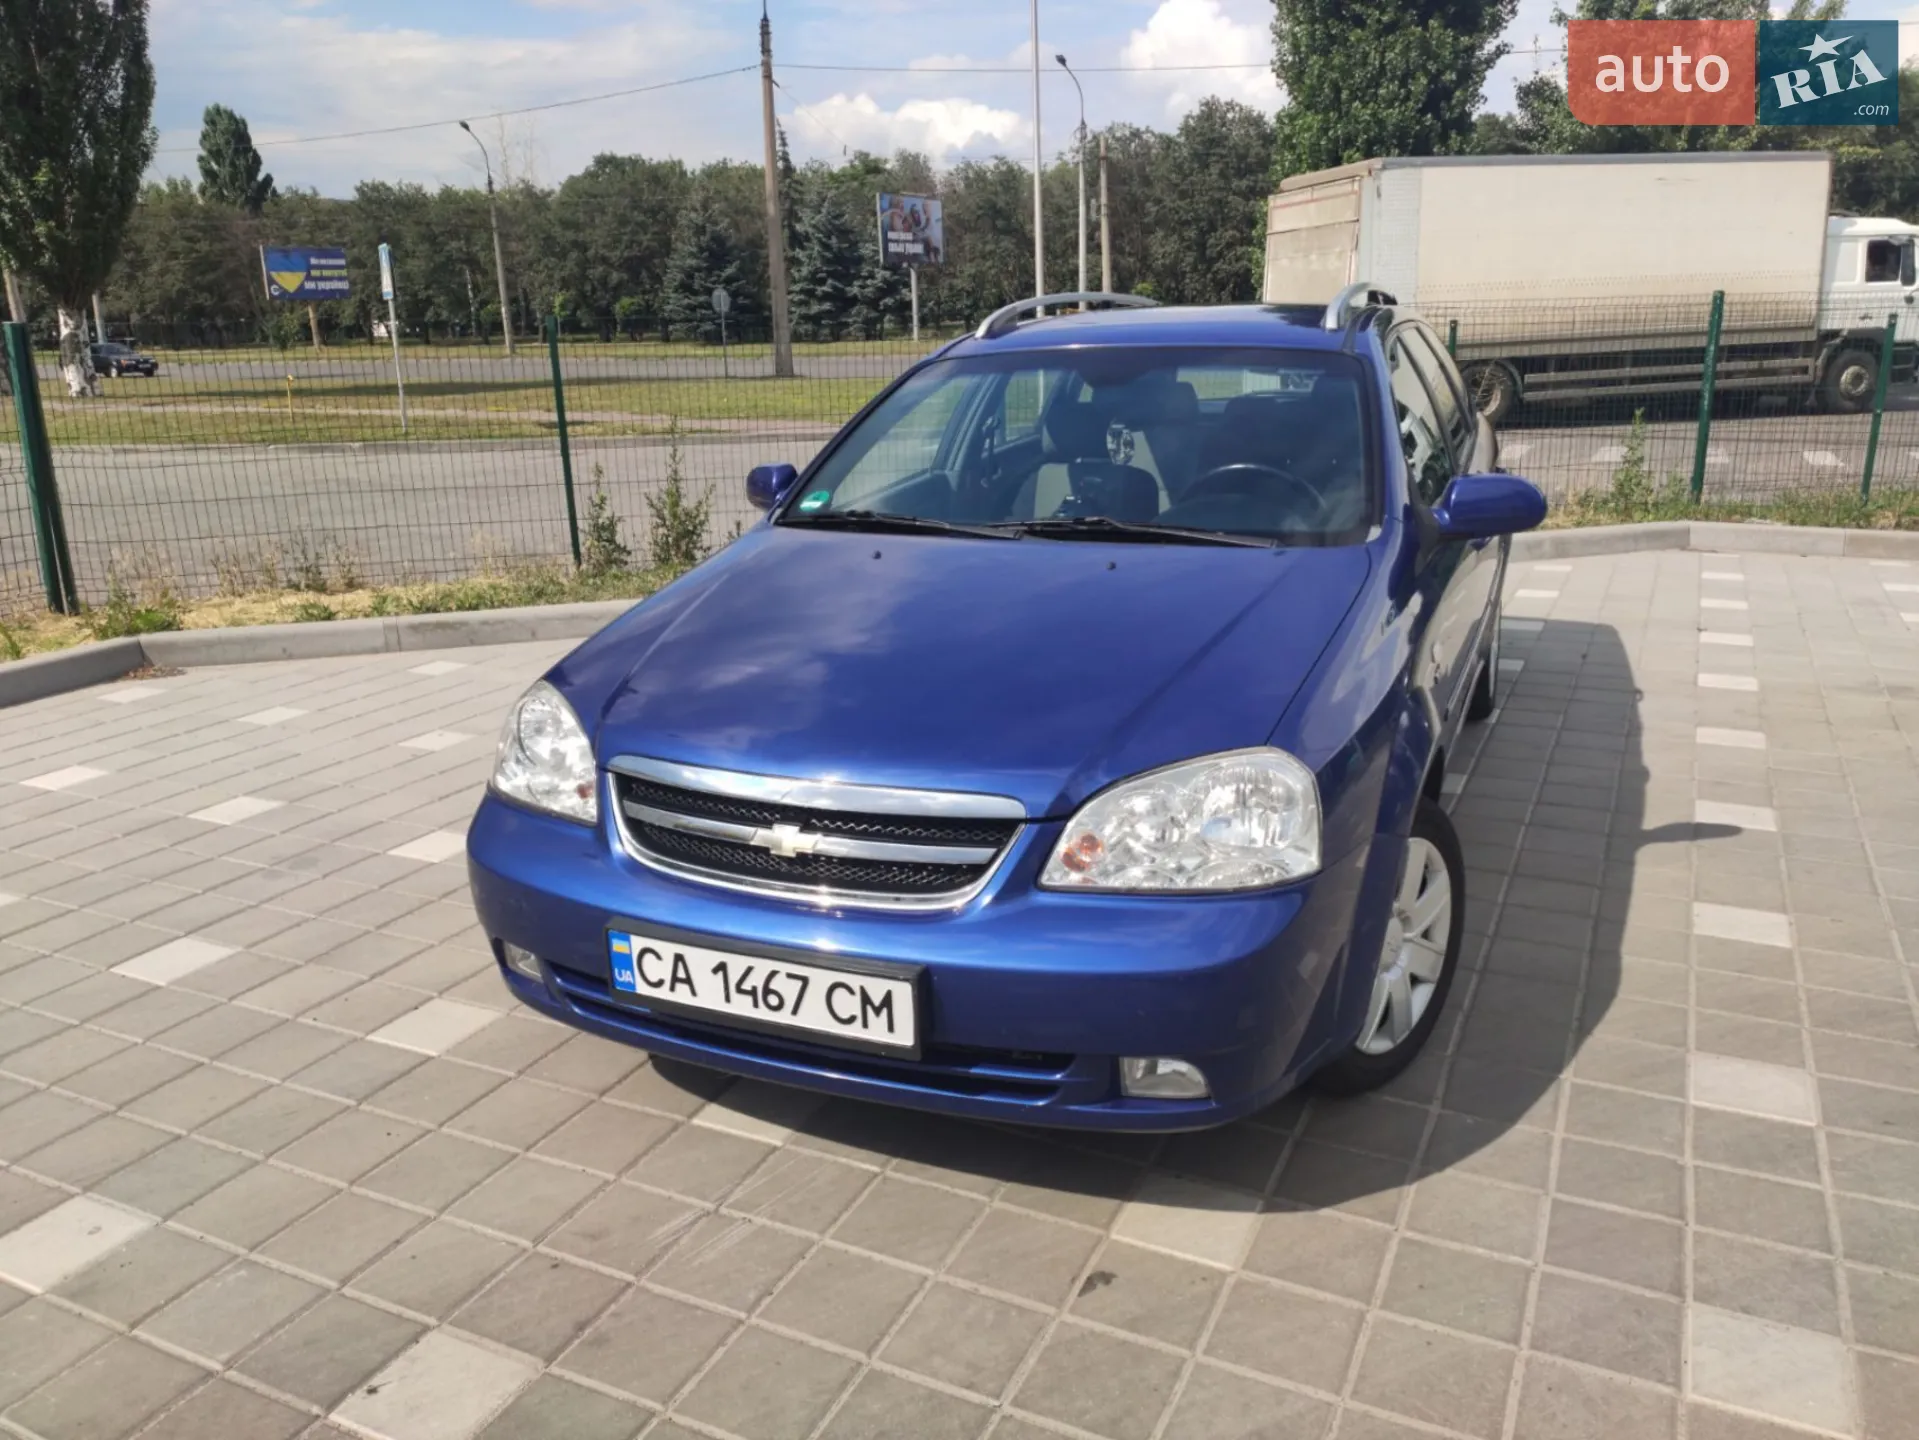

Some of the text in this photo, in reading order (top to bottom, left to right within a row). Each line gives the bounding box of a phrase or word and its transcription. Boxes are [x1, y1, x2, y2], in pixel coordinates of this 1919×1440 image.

[615, 968, 634, 985] UA
[636, 946, 895, 1034] CA 1467 CM
